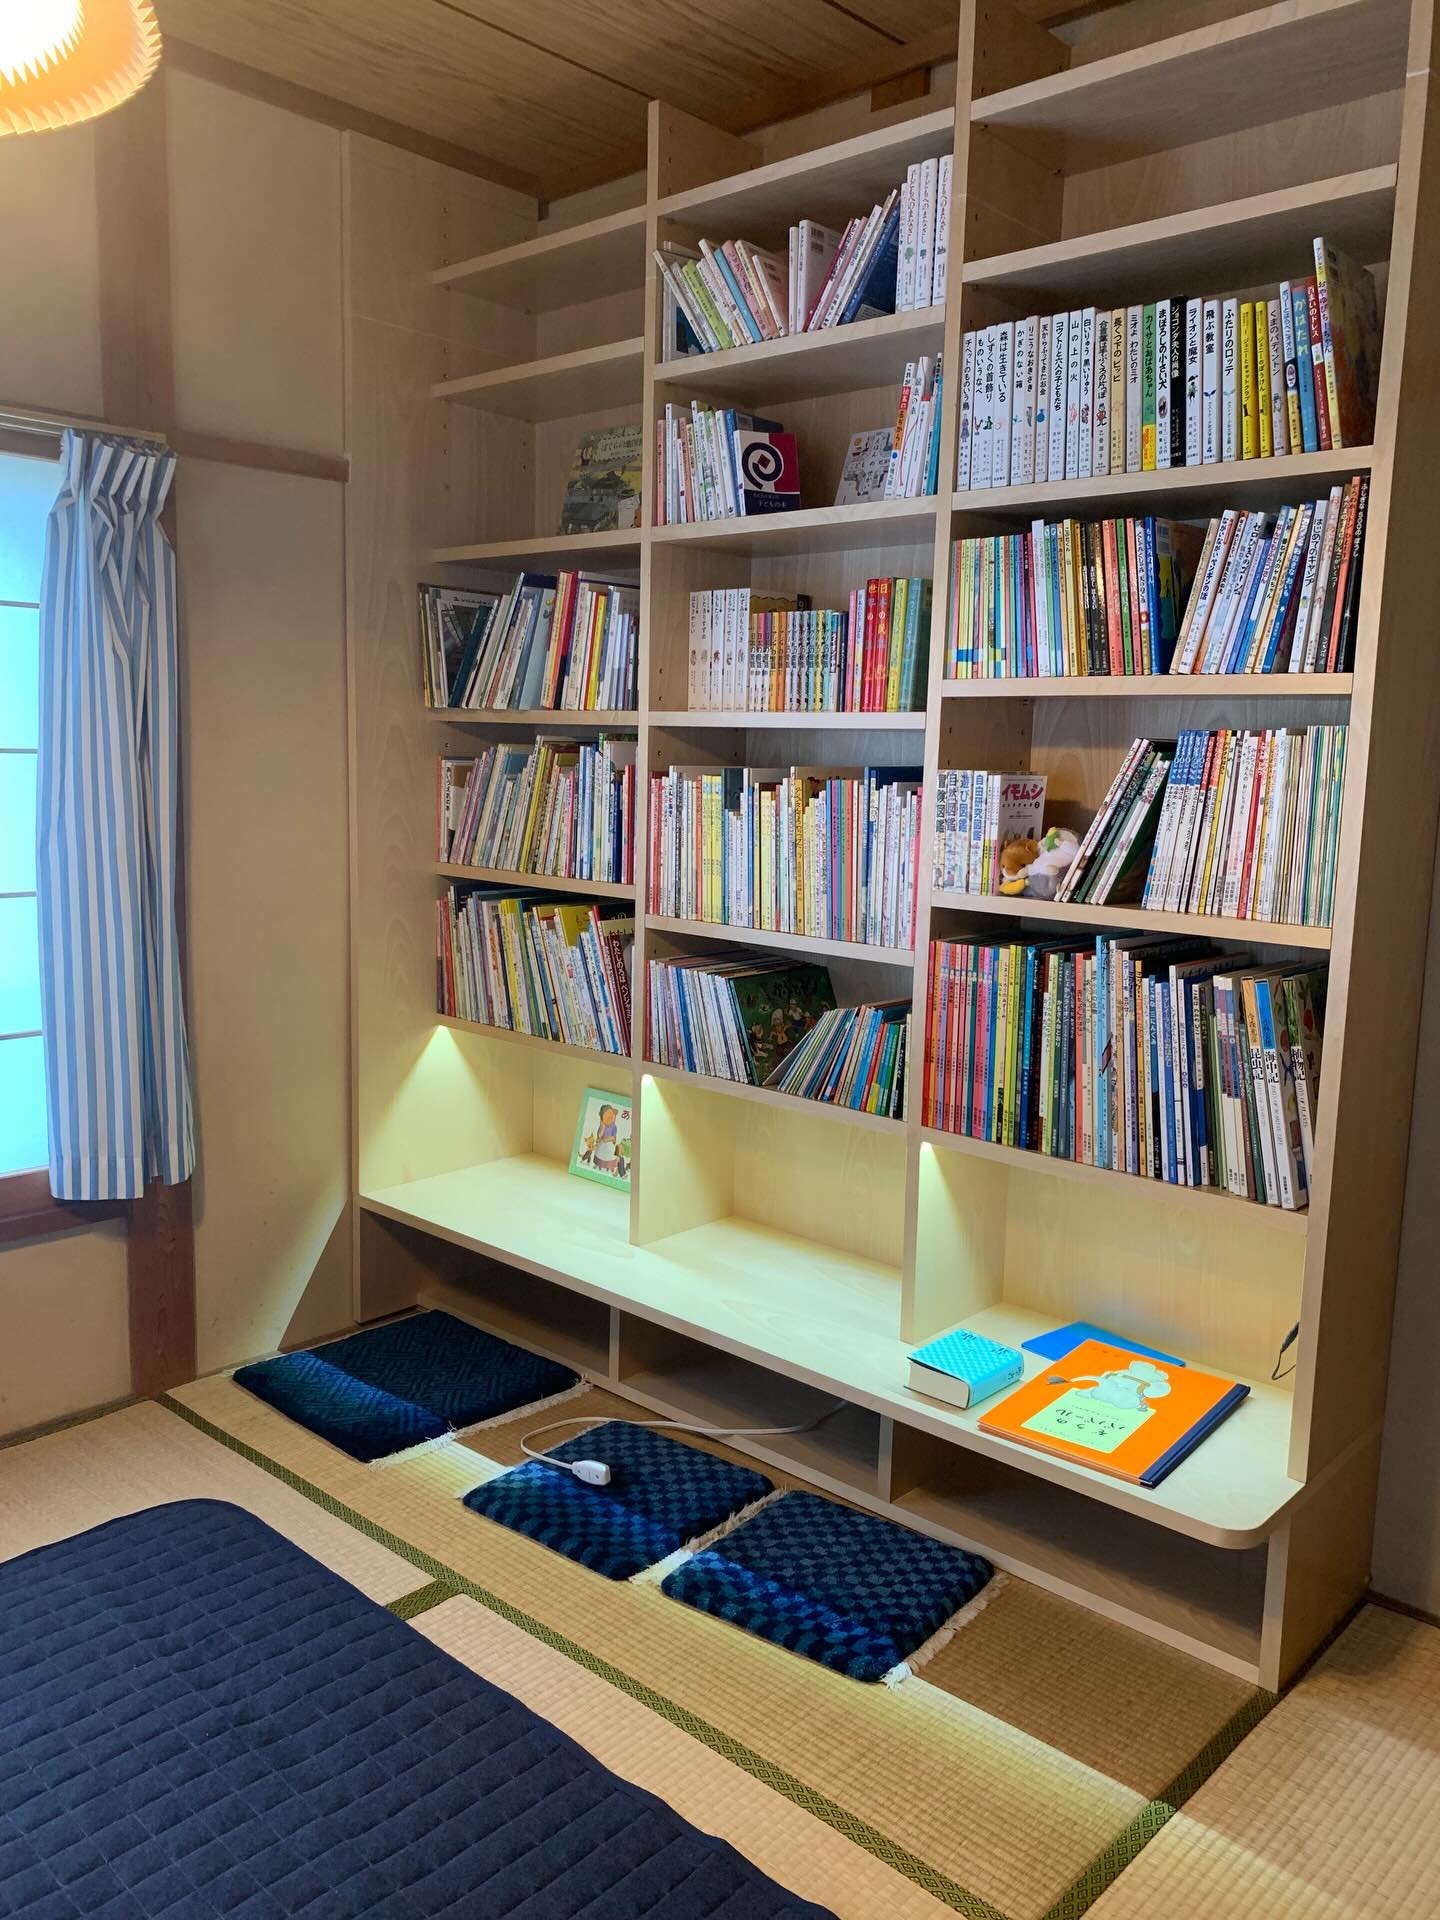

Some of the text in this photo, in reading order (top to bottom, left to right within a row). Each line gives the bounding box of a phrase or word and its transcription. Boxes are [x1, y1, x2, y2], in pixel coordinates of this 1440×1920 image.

[1016, 330, 1024, 389] かぎのない箱
[1069, 320, 1079, 382] 山の上の火
[1083, 318, 1092, 355] 白いりゅう
[1113, 317, 1122, 383] 長くつ下のピッピ
[1145, 315, 1153, 398] カイサとおばあちゃん
[1158, 309, 1168, 390] まぼろしの小さい犬
[1188, 307, 1198, 366] ライオンと魔女
[1205, 309, 1215, 355] 飛ぶ教室
[1224, 308, 1235, 377] ふたりのロッテ
[1269, 310, 1281, 377] くまのパディントン
[976, 339, 985, 394] ものいうなべ
[985, 333, 996, 403] しずくの首飾り
[998, 331, 1009, 402] 森は生きている
[1304, 518, 1323, 587] はじめてのキャンプ
[935, 774, 947, 833] 冒険図鑑
[946, 773, 957, 832] 自然図鑑
[958, 772, 969, 832] 遊び図鑑
[1002, 783, 1044, 801] イモムシ
[1250, 1048, 1264, 1081] 昆虫記
[1265, 1051, 1280, 1083] 海中記
